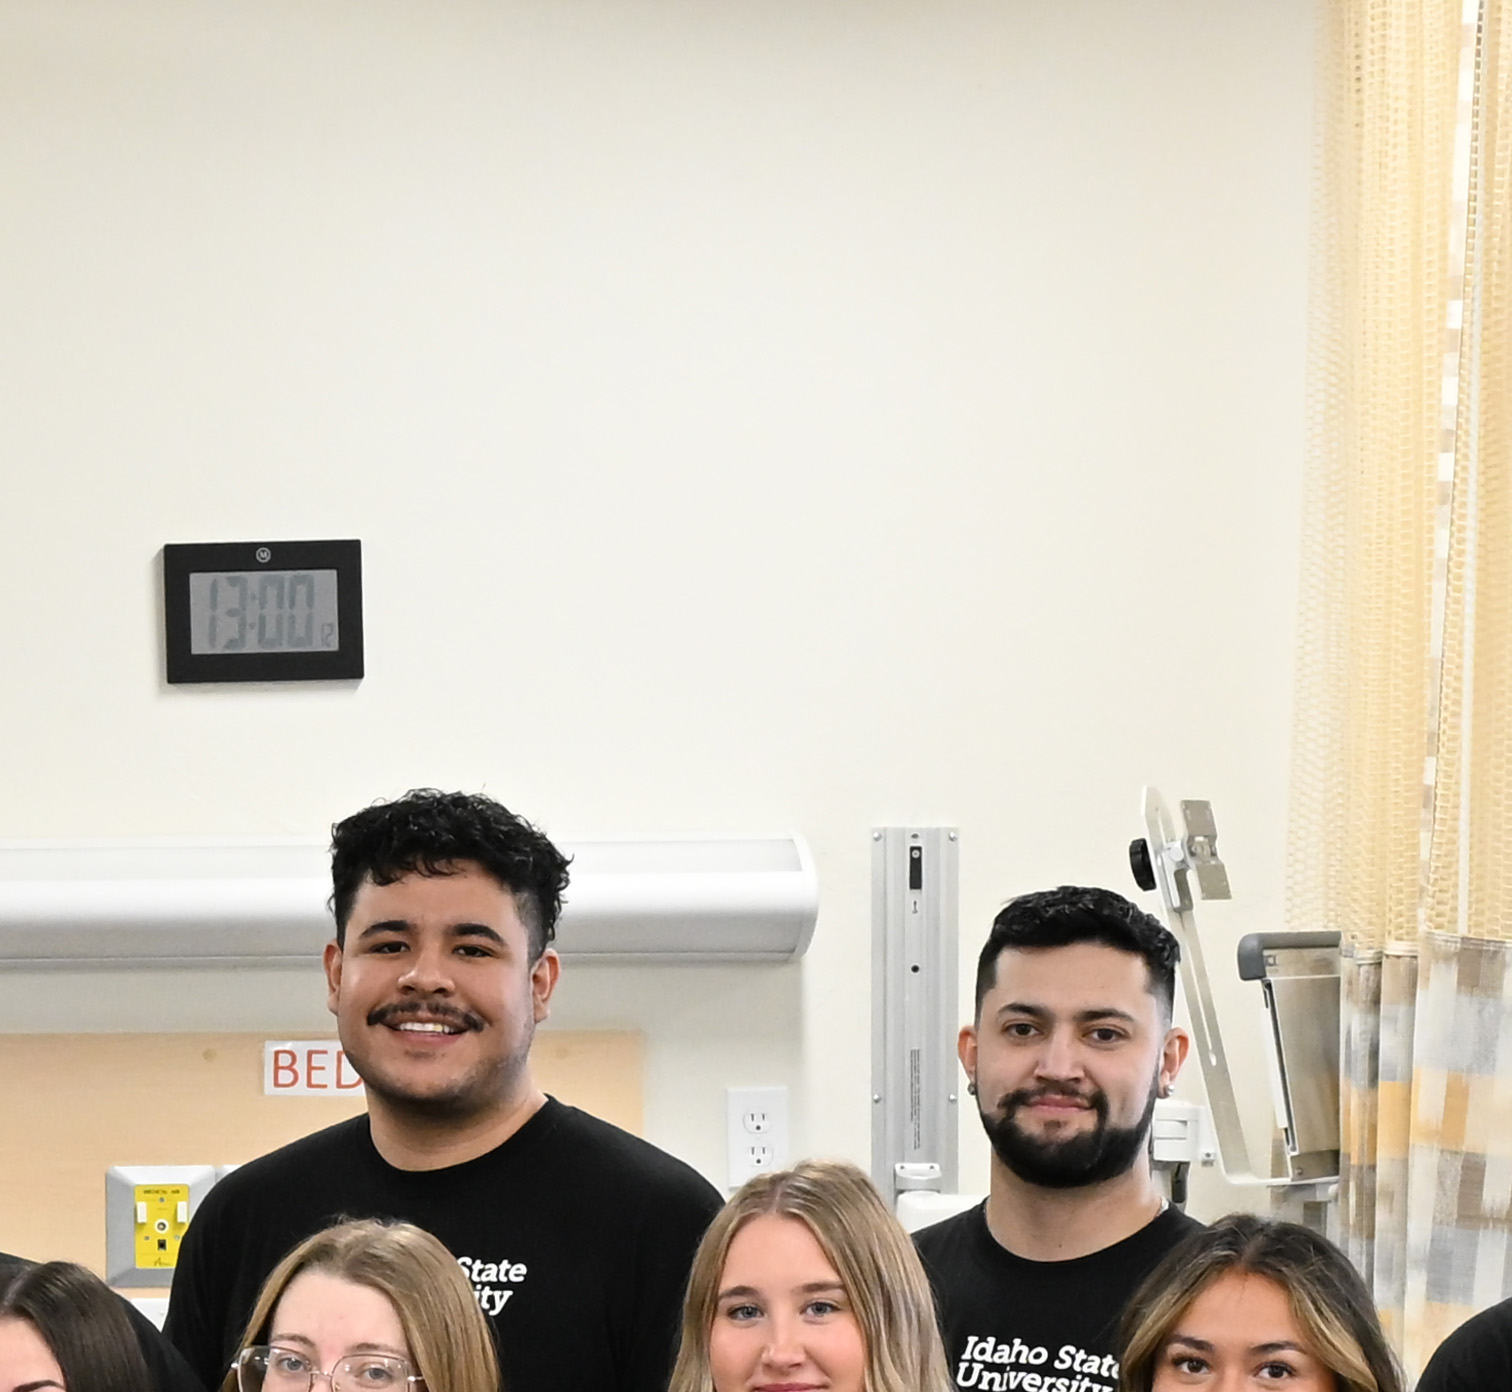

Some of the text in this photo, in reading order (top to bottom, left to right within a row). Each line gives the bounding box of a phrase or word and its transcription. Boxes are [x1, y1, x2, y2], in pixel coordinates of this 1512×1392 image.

[209, 574, 315, 650] 13:00
[273, 1050, 363, 1089] BED
[457, 1256, 528, 1283] State
[961, 1335, 1048, 1365] Idaho
